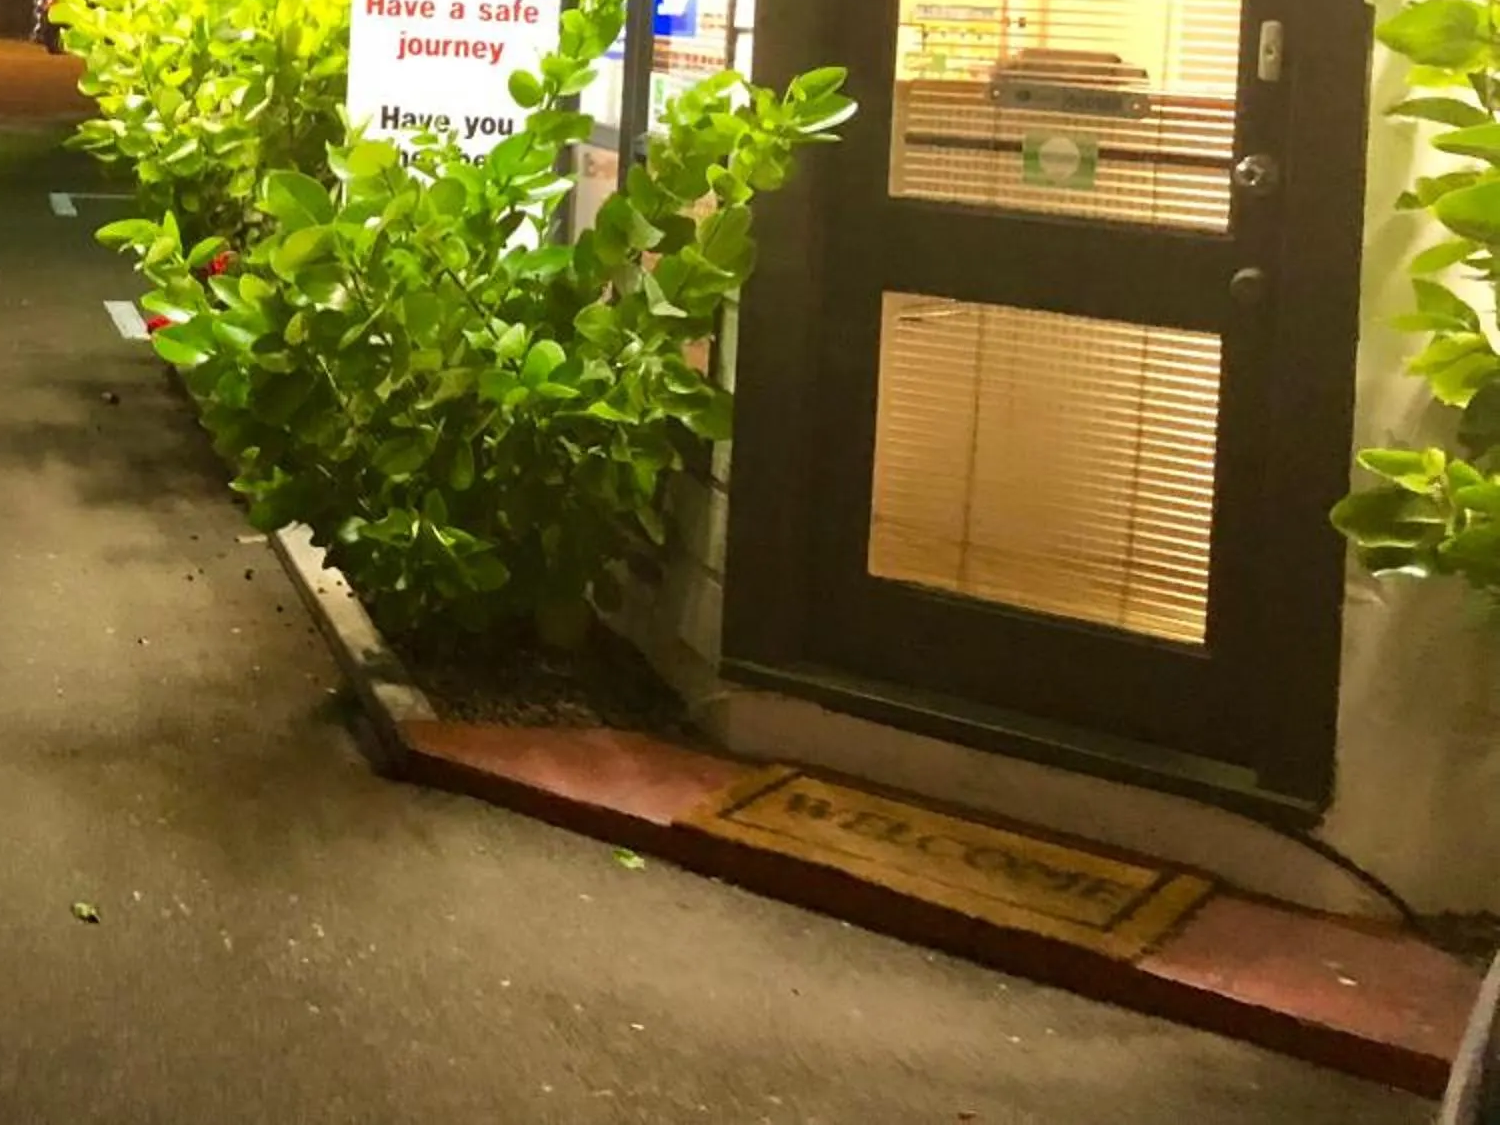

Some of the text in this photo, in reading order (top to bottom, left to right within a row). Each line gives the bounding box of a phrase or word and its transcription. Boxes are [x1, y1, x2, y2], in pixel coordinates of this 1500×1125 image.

[449, 1, 465, 19] a
[397, 31, 505, 65] journey
[381, 105, 514, 139] Have you
